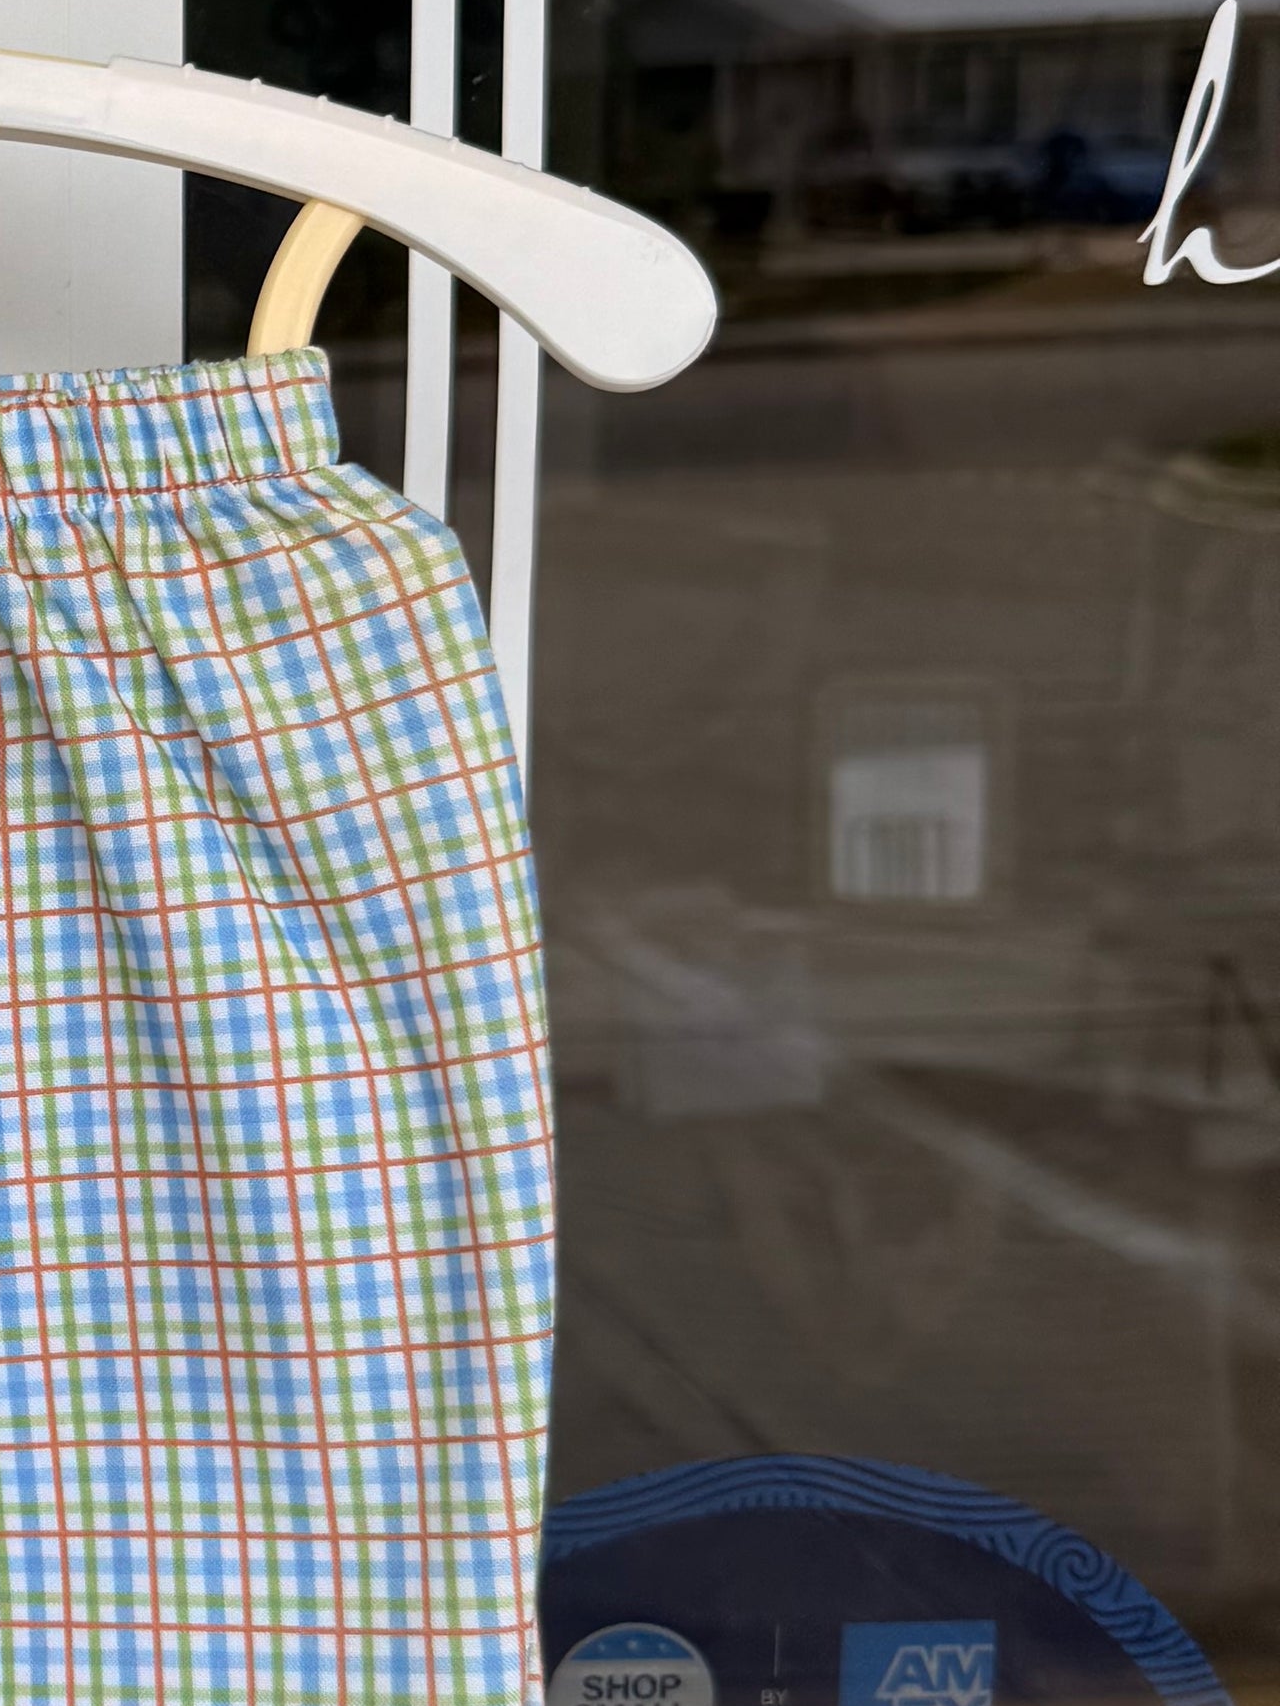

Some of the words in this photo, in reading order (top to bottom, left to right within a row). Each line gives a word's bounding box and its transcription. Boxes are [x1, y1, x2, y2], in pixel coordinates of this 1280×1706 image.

[875, 1643, 994, 1699] AM
[583, 1673, 682, 1701] SHOP
[760, 1689, 787, 1706] BY
